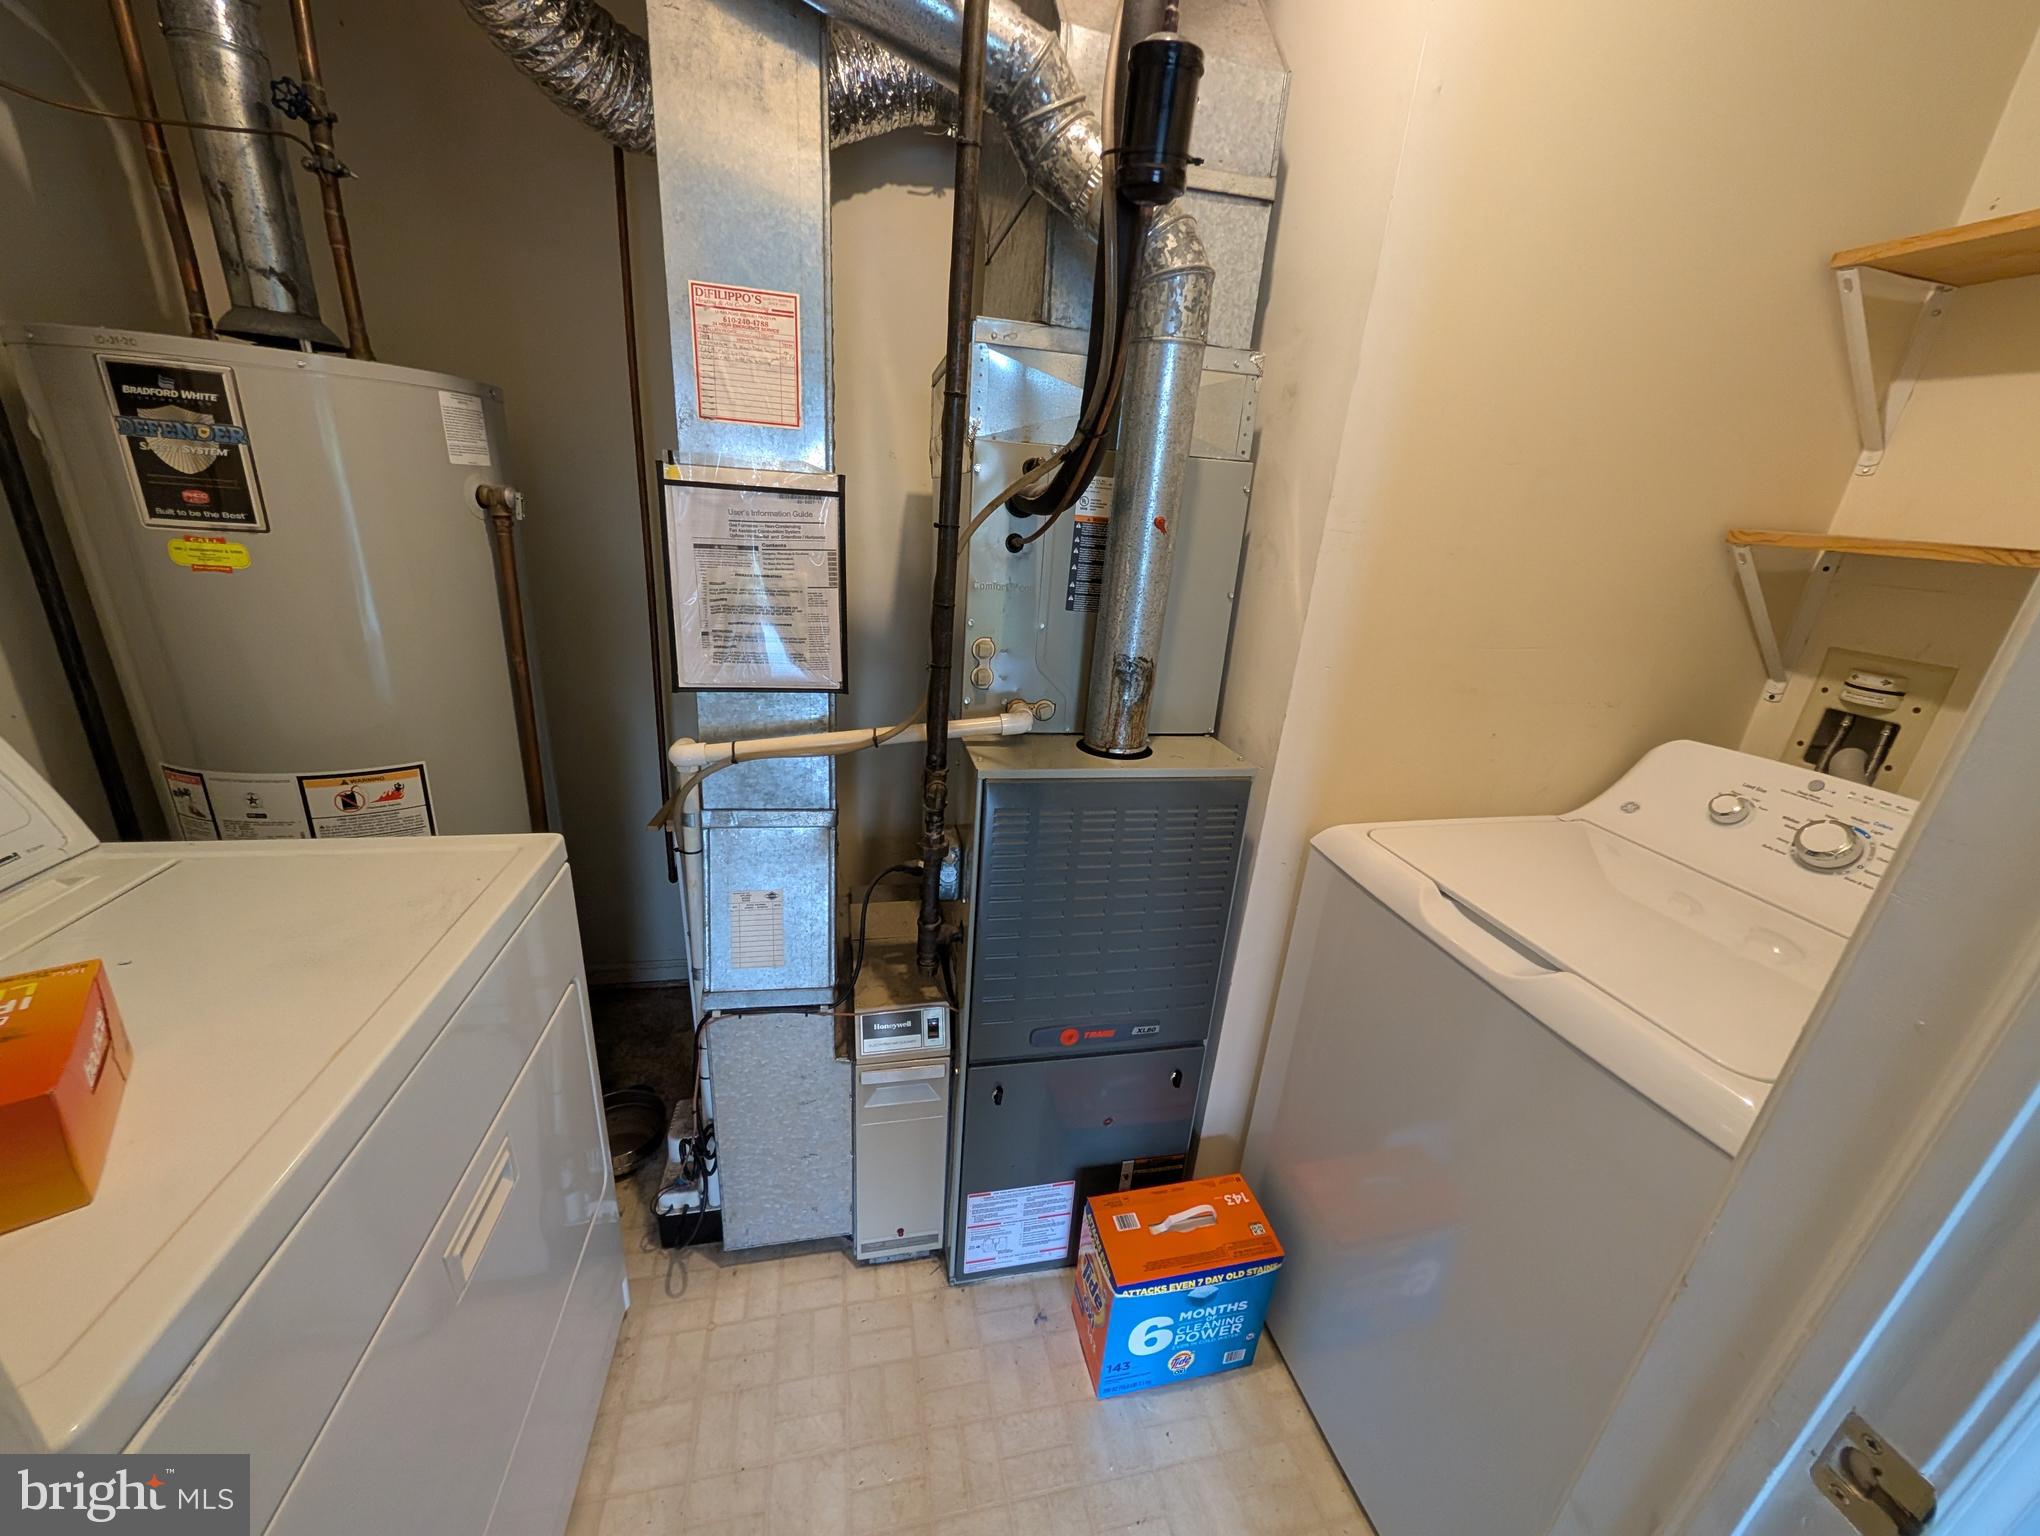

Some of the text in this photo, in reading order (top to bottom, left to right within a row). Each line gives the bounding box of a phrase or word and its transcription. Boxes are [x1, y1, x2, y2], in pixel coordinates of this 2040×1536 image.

[695, 287, 762, 304] DiFILIPPO'S
[122, 384, 179, 398] BRADFORD
[181, 389, 219, 402] WHITE
[116, 417, 249, 444] DEFENDER
[182, 444, 228, 457] SYSTEM
[155, 507, 175, 516] Built
[176, 508, 187, 516] to
[188, 509, 202, 517] be
[221, 511, 246, 519] Best
[750, 509, 791, 518] Information
[792, 510, 813, 518] Guide
[350, 776, 385, 784] WARNING
[873, 1020, 912, 1031] Honeywell
[1084, 1028, 1116, 1040] TRANE
[1223, 1191, 1250, 1206] 143
[1122, 1285, 1168, 1297] ATTACKS
[1169, 1279, 1196, 1292] EVEN
[1197, 1278, 1204, 1288] 7
[1205, 1274, 1228, 1285] DAY
[1226, 1271, 1245, 1281] OLD
[1128, 1301, 1249, 1356] 6 MONTHS
[1176, 1315, 1245, 1335] CLEANING
[1174, 1323, 1243, 1346] POWER
[1106, 1361, 1131, 1374] 143
[1170, 1355, 1192, 1370] Tide
